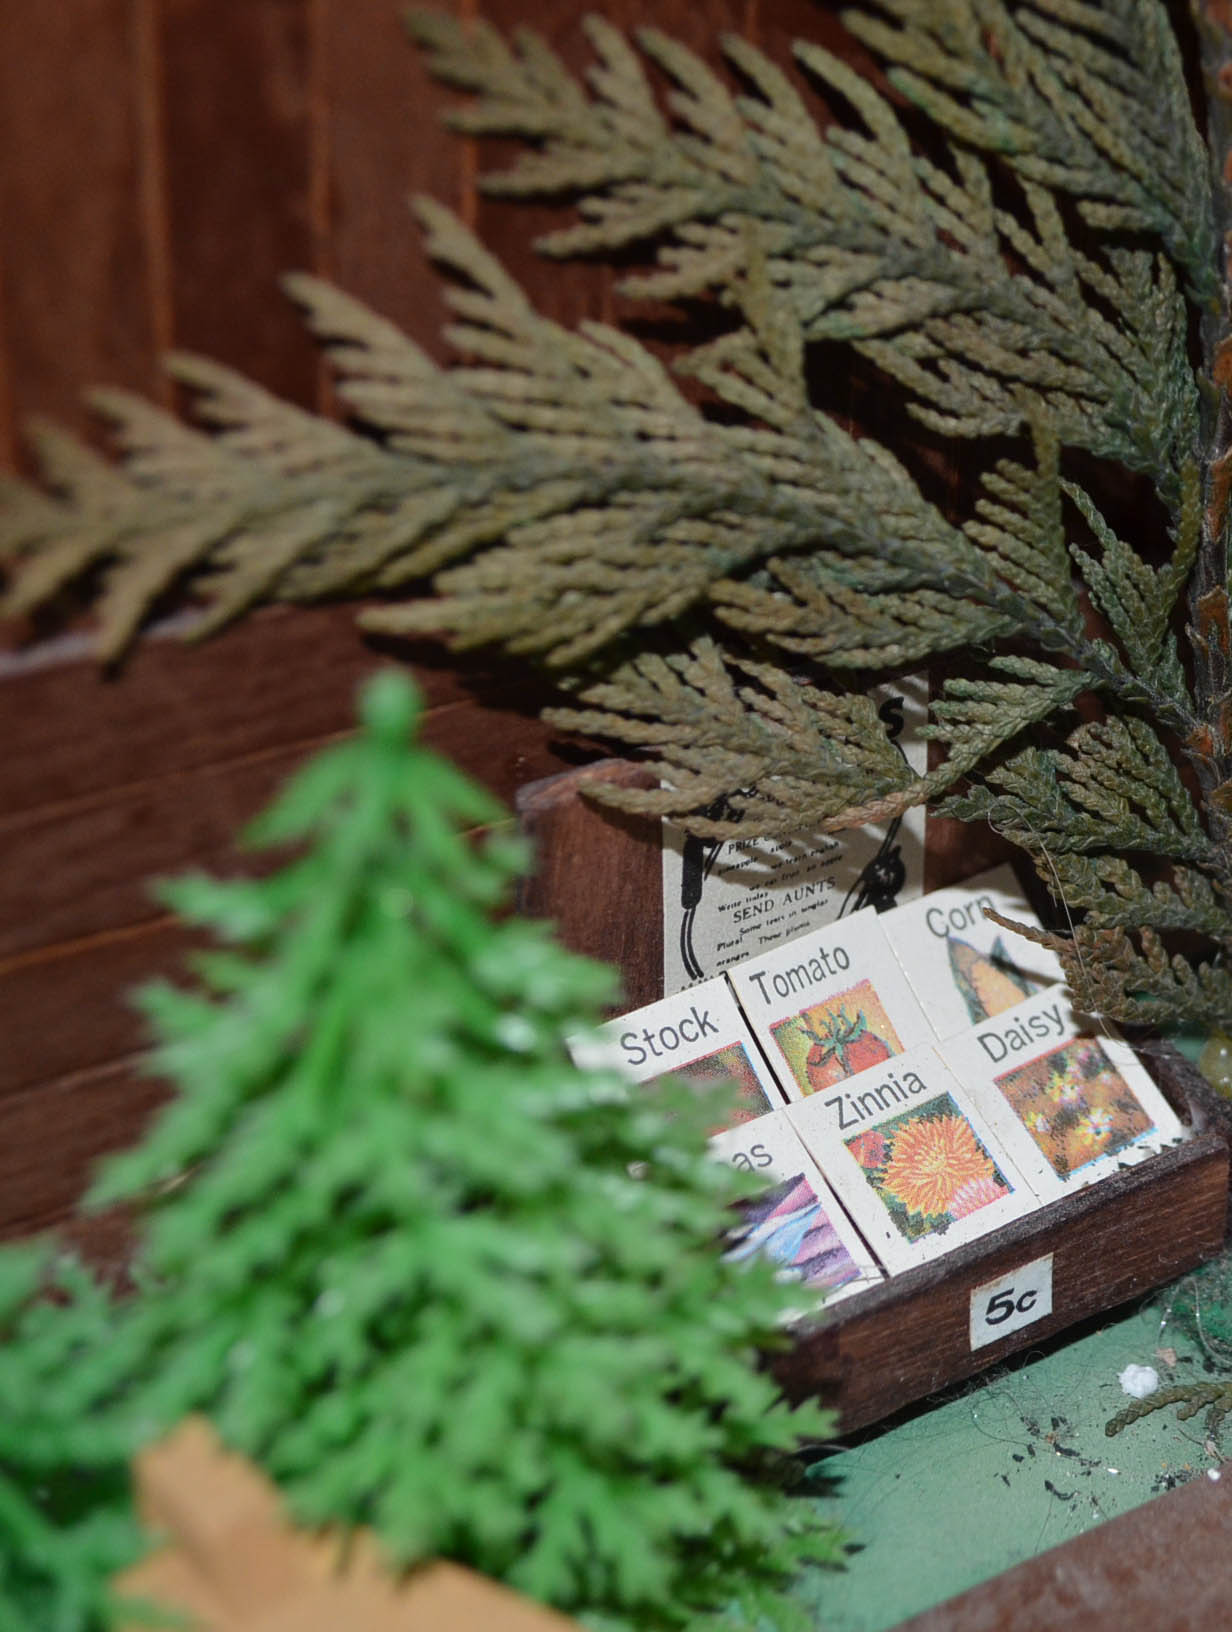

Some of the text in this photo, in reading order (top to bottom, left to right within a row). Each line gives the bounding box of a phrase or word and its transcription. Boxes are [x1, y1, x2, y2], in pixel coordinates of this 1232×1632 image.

[728, 838, 759, 854] PRIZE
[733, 899, 775, 924] SEND
[783, 876, 836, 906] AUNTS
[926, 895, 996, 938] Corn
[749, 946, 850, 1005] Tomato
[620, 1006, 719, 1066] Stock
[977, 1004, 1065, 1063] Daisy
[824, 1071, 928, 1131] Zinnia
[985, 1288, 1038, 1325] 5c
